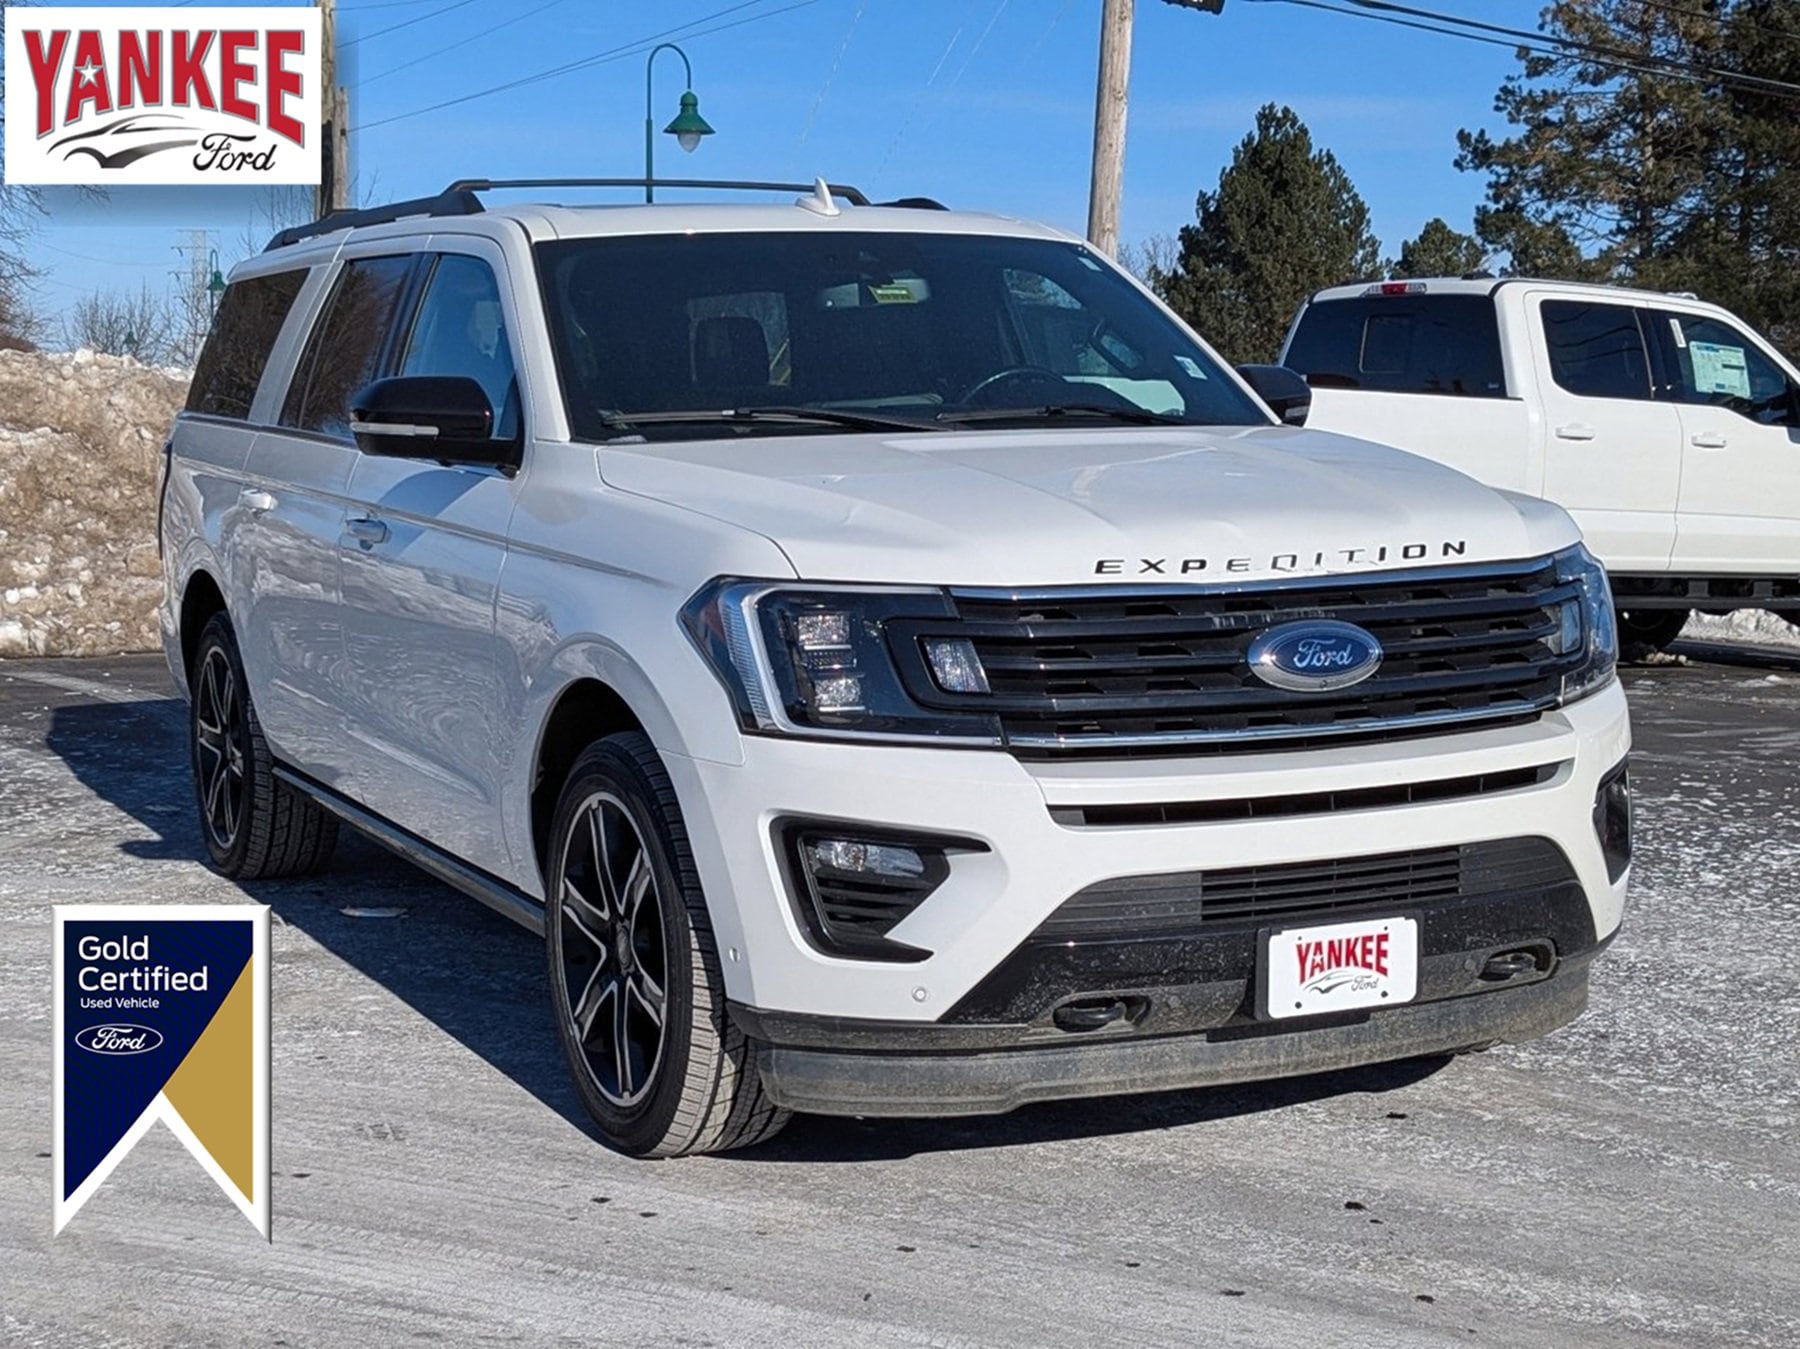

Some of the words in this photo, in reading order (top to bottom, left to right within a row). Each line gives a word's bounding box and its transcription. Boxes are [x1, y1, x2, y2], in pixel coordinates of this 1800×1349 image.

[1095, 540, 1467, 575] EXPEDITION
[1293, 638, 1352, 669] Ford
[1296, 933, 1389, 985] YANKEE
[1351, 975, 1379, 991] Ford
